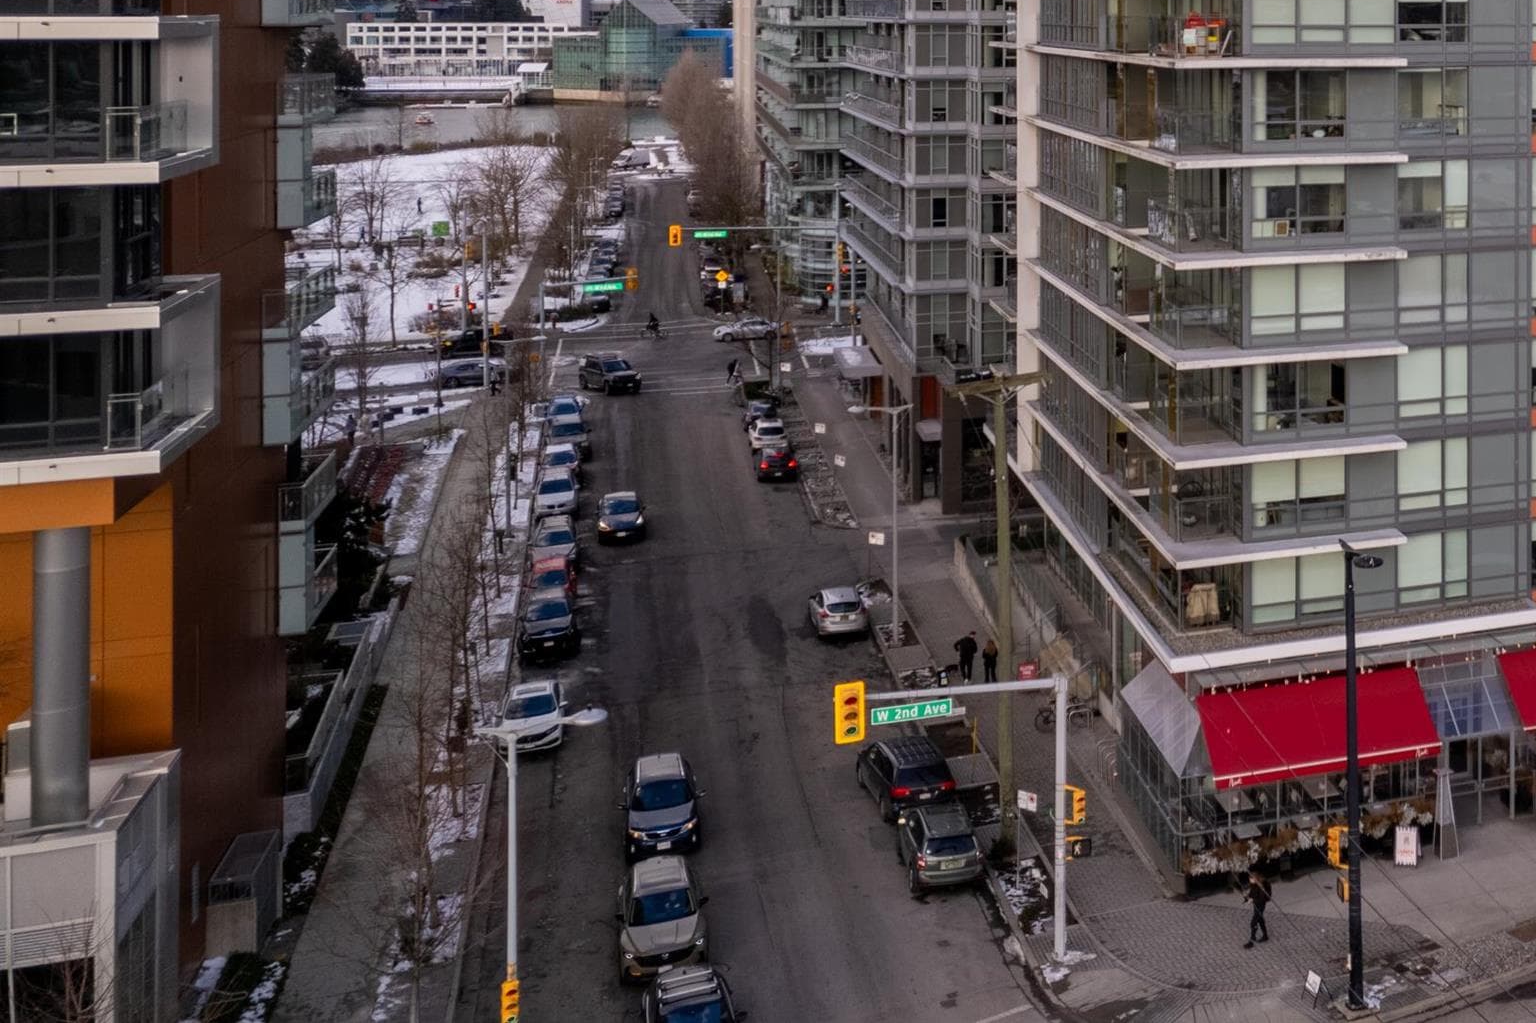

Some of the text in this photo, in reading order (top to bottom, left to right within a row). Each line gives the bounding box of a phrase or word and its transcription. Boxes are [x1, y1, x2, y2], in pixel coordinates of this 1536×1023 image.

[877, 703, 947, 722] W 2nd Ave
